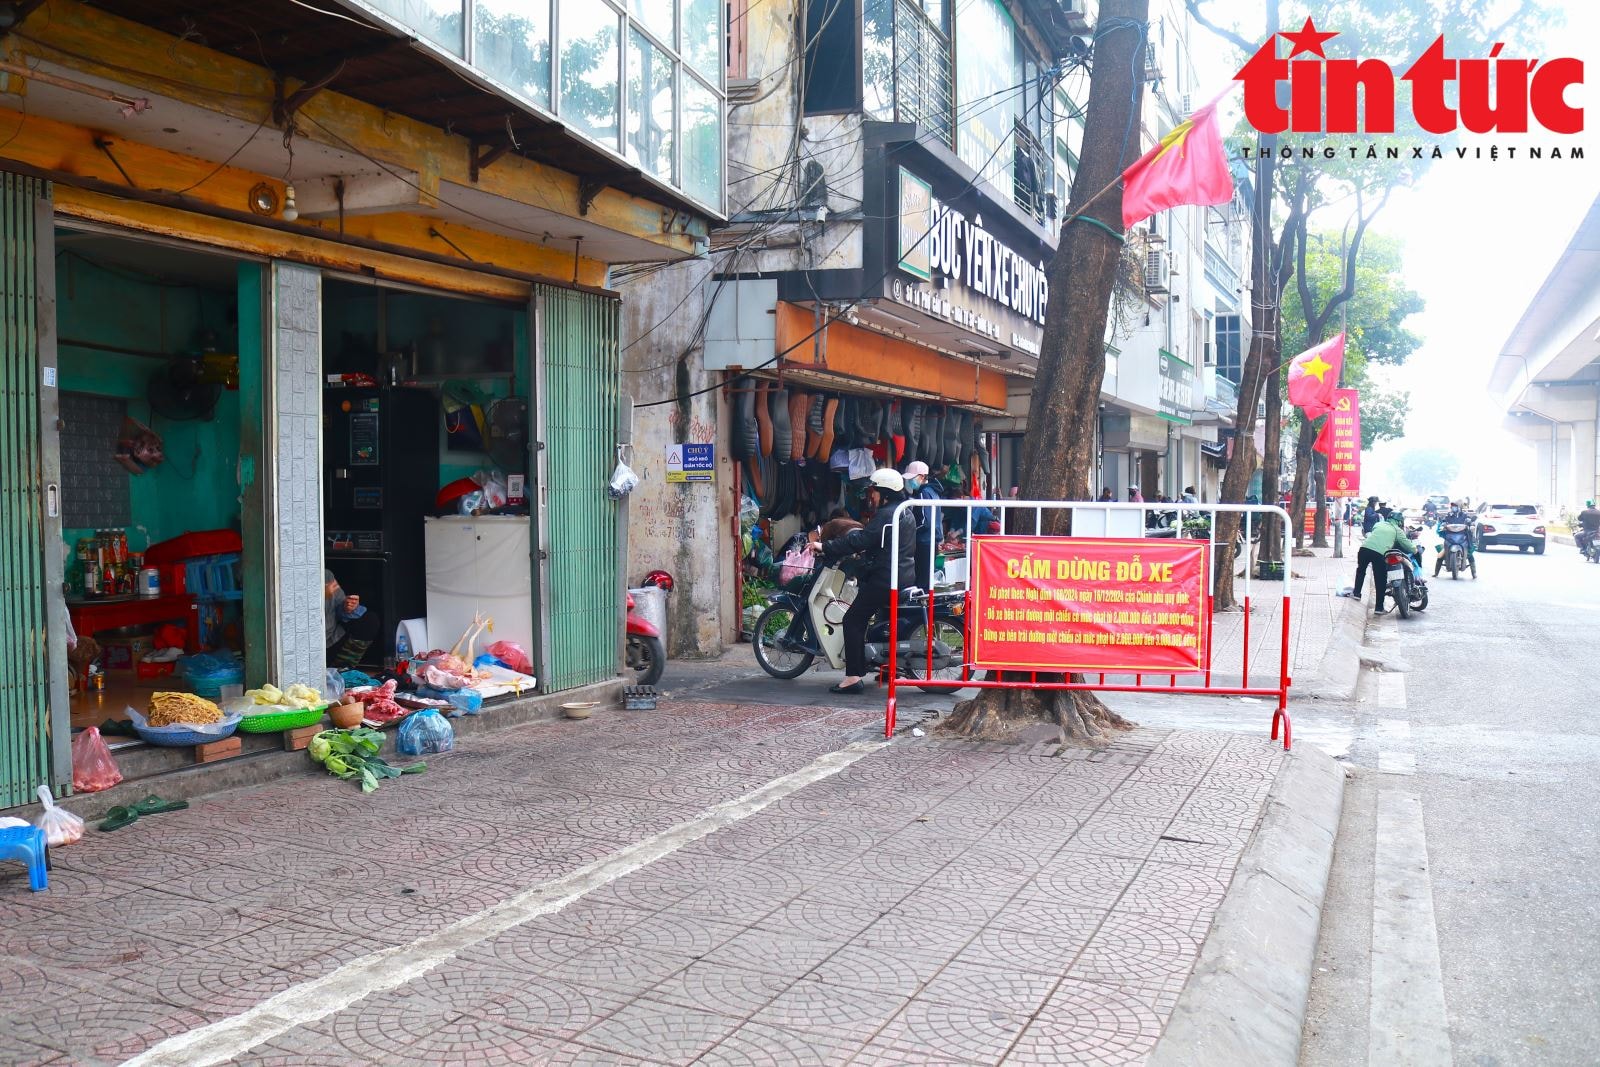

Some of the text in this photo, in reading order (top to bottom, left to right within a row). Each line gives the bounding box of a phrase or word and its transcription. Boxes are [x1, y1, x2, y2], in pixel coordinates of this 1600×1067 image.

[931, 196, 963, 288] BỌC
[964, 213, 993, 298] YÊN
[993, 239, 1010, 306] XE
[1011, 259, 1048, 325] CHUYÊ
[1007, 552, 1173, 583] CẤM DỪNG ĐỖ XE
[998, 587, 1010, 602] phạt
[1026, 588, 1038, 602] Nghị
[1040, 588, 1052, 603] định
[1079, 589, 1093, 603] ngày
[1125, 589, 1135, 603] của
[1136, 590, 1152, 604] Chính
[1164, 593, 1175, 605] quy
[996, 609, 1003, 620] xe
[1072, 609, 1079, 622] có
[998, 631, 1006, 642] xe
[1075, 630, 1082, 644] có
